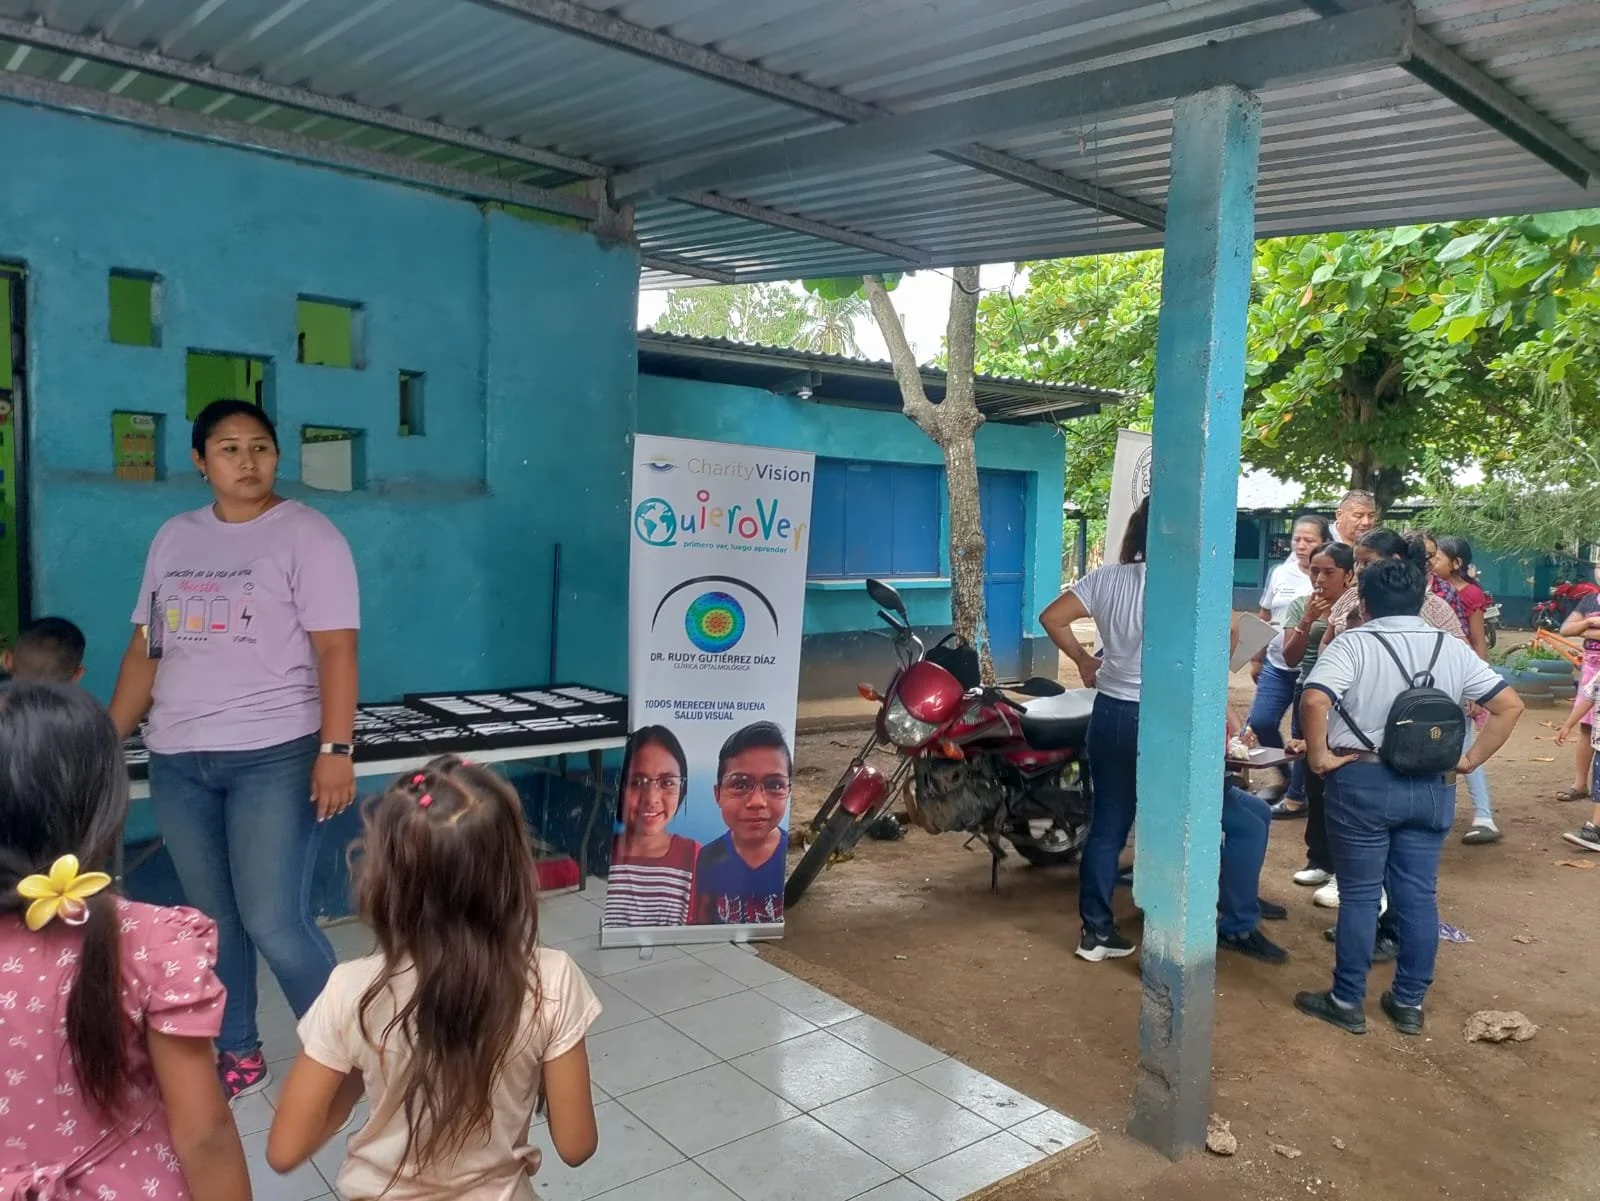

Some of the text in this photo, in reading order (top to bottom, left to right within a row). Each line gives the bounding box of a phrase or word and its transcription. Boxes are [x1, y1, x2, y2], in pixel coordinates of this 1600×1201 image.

[683, 541, 788, 554] primero ver, luego aprender
[650, 652, 776, 665] DR. RUDY GUTIÉRREZ DÍAZ
[645, 700, 765, 711] TODOS MERECEN UNA BUENA
[674, 711, 734, 720] SALUD VISUAL
